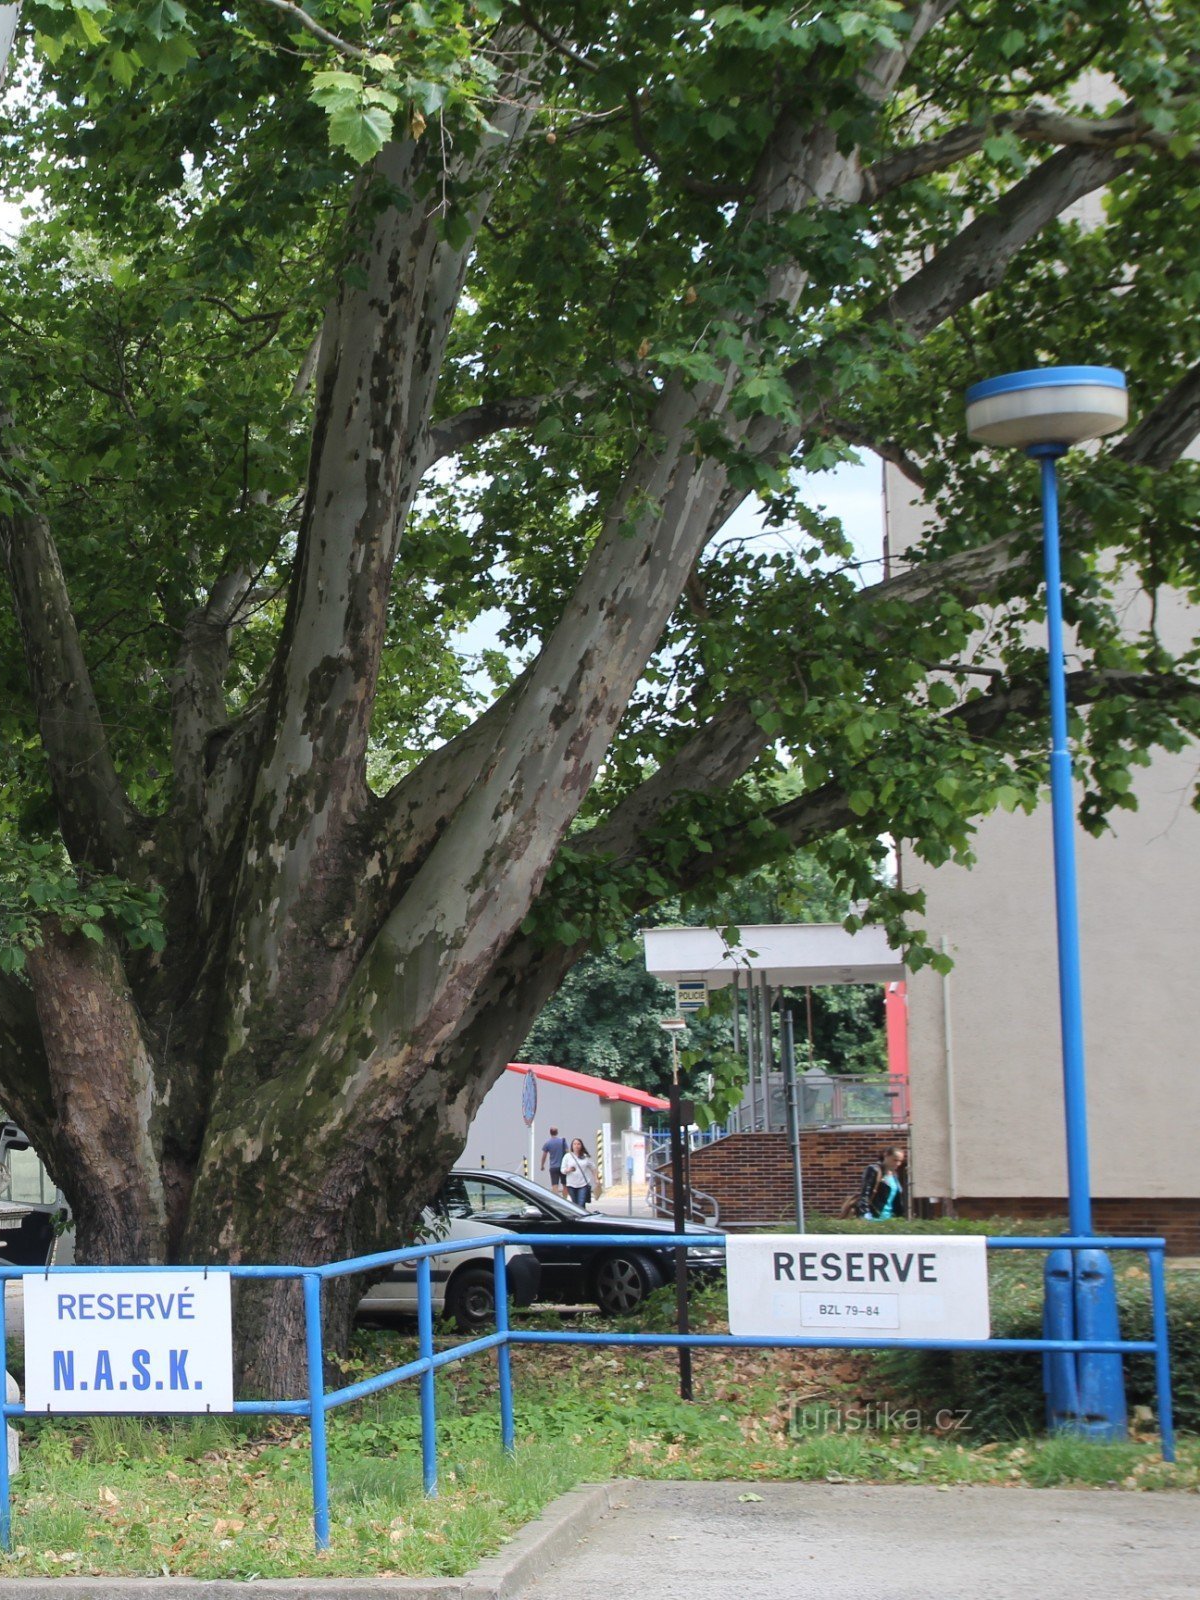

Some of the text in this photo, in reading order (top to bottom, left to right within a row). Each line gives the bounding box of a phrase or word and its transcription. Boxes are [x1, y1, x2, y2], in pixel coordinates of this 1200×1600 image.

[679, 991, 705, 1000] POLICIE
[773, 1252, 938, 1283] RESERVE
[57, 1285, 196, 1320] RESERVÉ
[819, 1304, 842, 1316] BZL
[52, 1348, 203, 1391] N.A.S.K.
